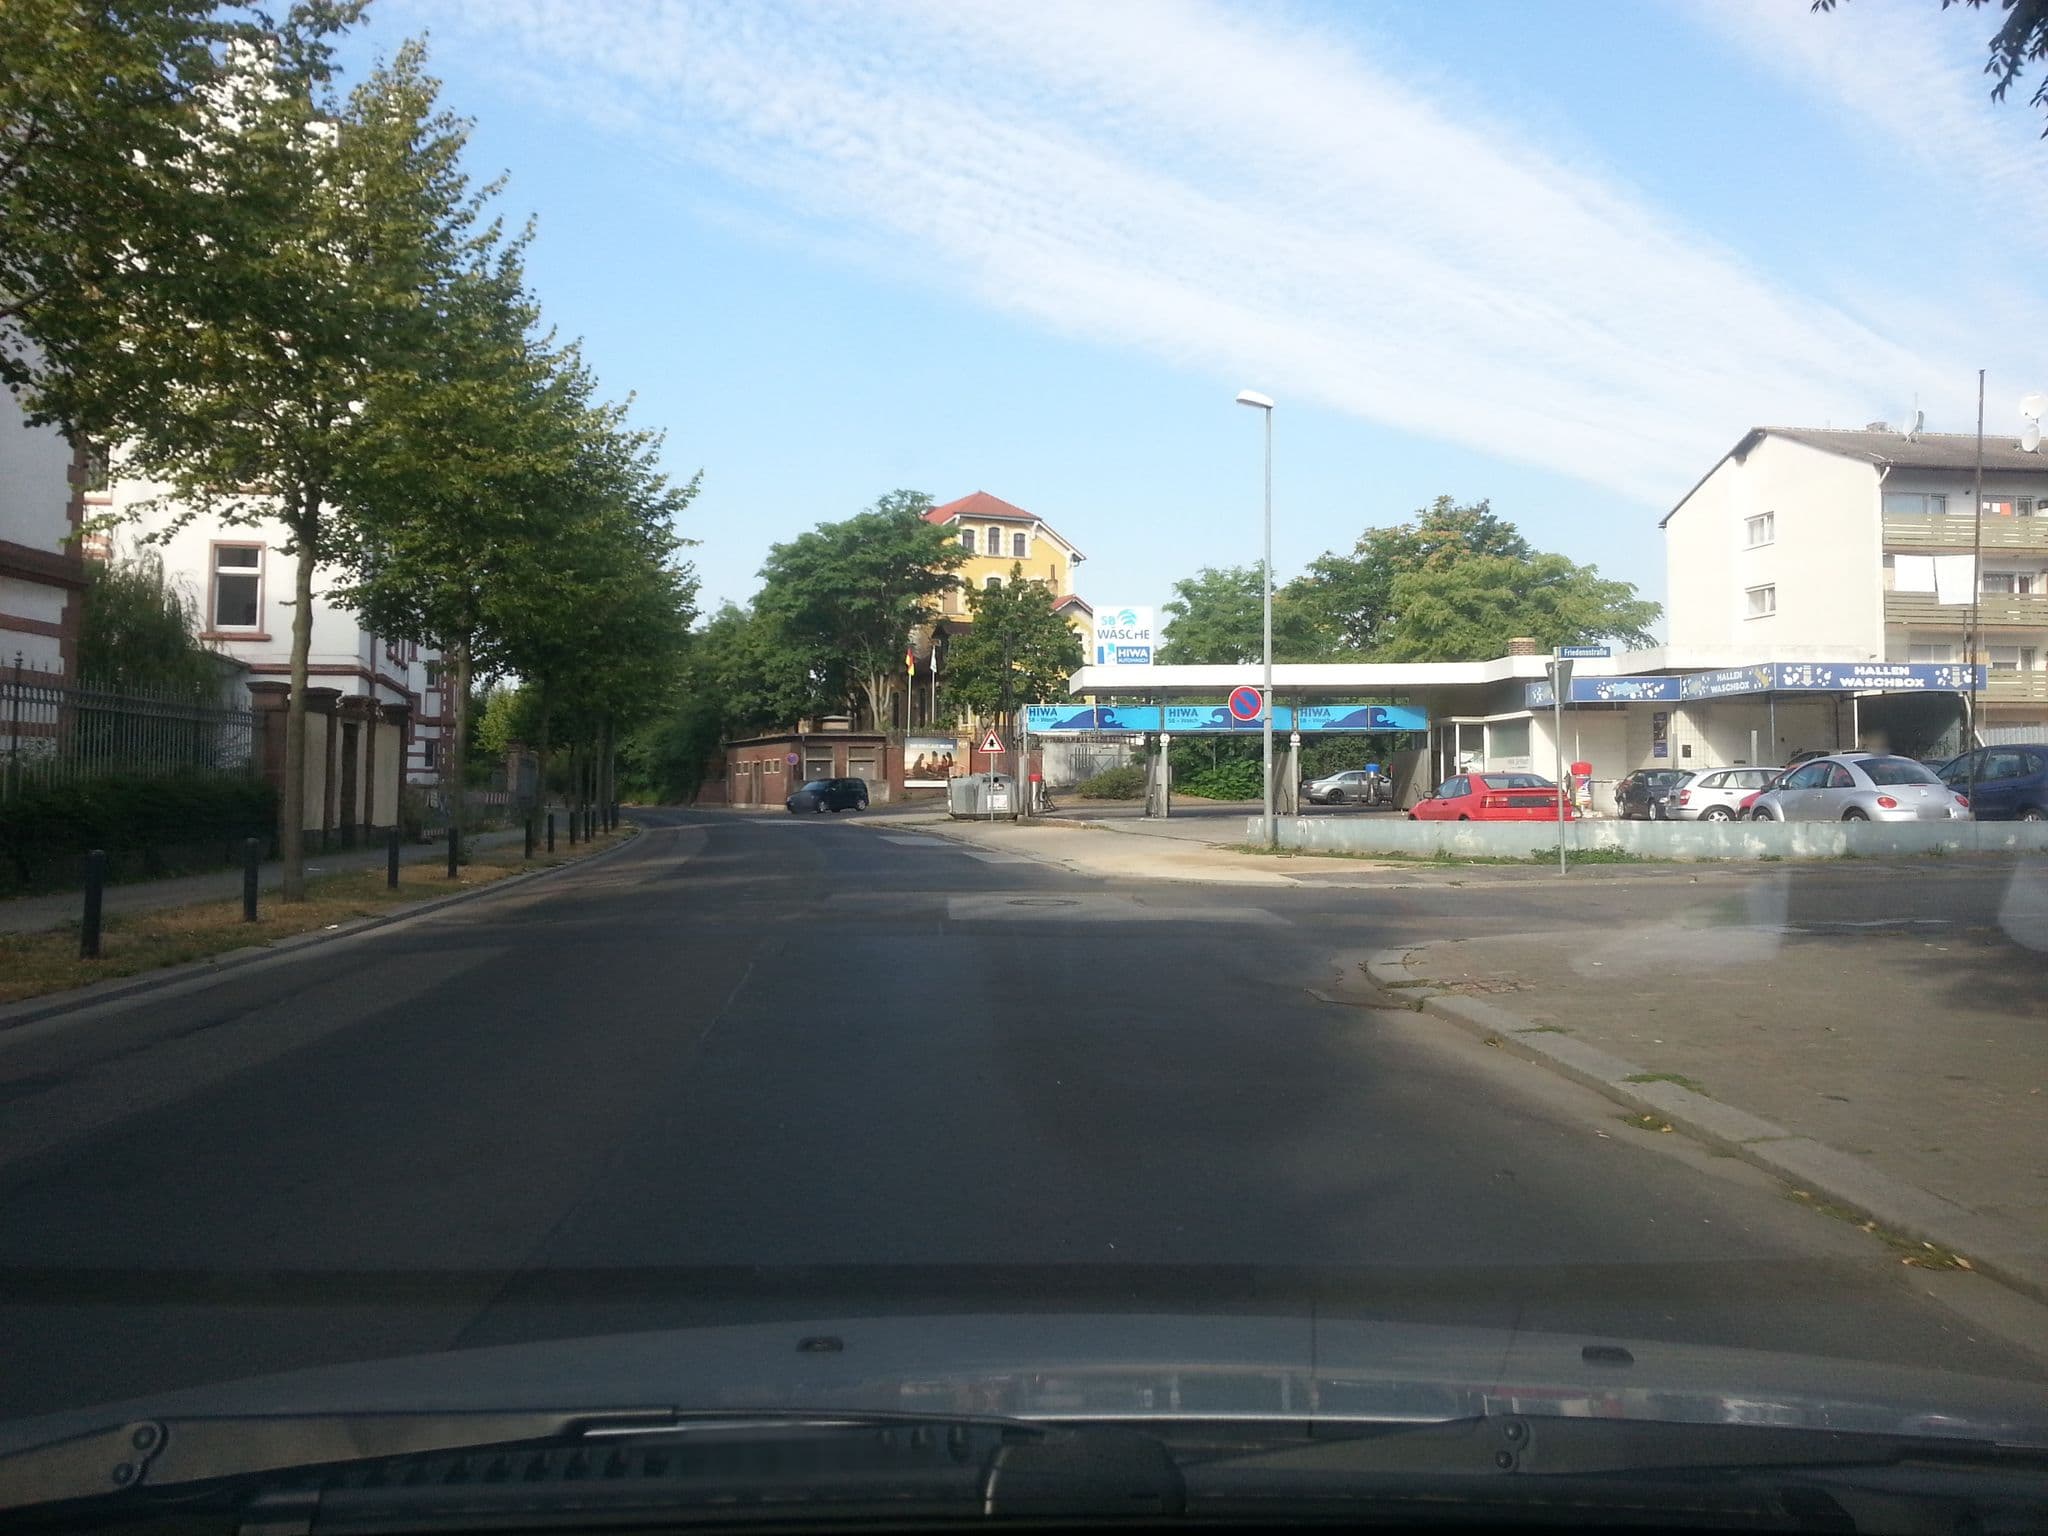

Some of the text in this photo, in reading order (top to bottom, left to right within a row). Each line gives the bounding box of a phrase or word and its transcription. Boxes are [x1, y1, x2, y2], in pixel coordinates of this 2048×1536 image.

[1101, 615, 1116, 626] SB
[1118, 649, 1148, 658] HIWA
[1855, 666, 1909, 676] HALLEN
[1716, 671, 1743, 682] HALLEN
[1710, 681, 1750, 694] WASCHBOX
[1840, 678, 1925, 688] WASCHBOX
[1029, 707, 1058, 717] HIWA
[1169, 708, 1199, 718] HIWA
[1301, 707, 1331, 717] HIWA
